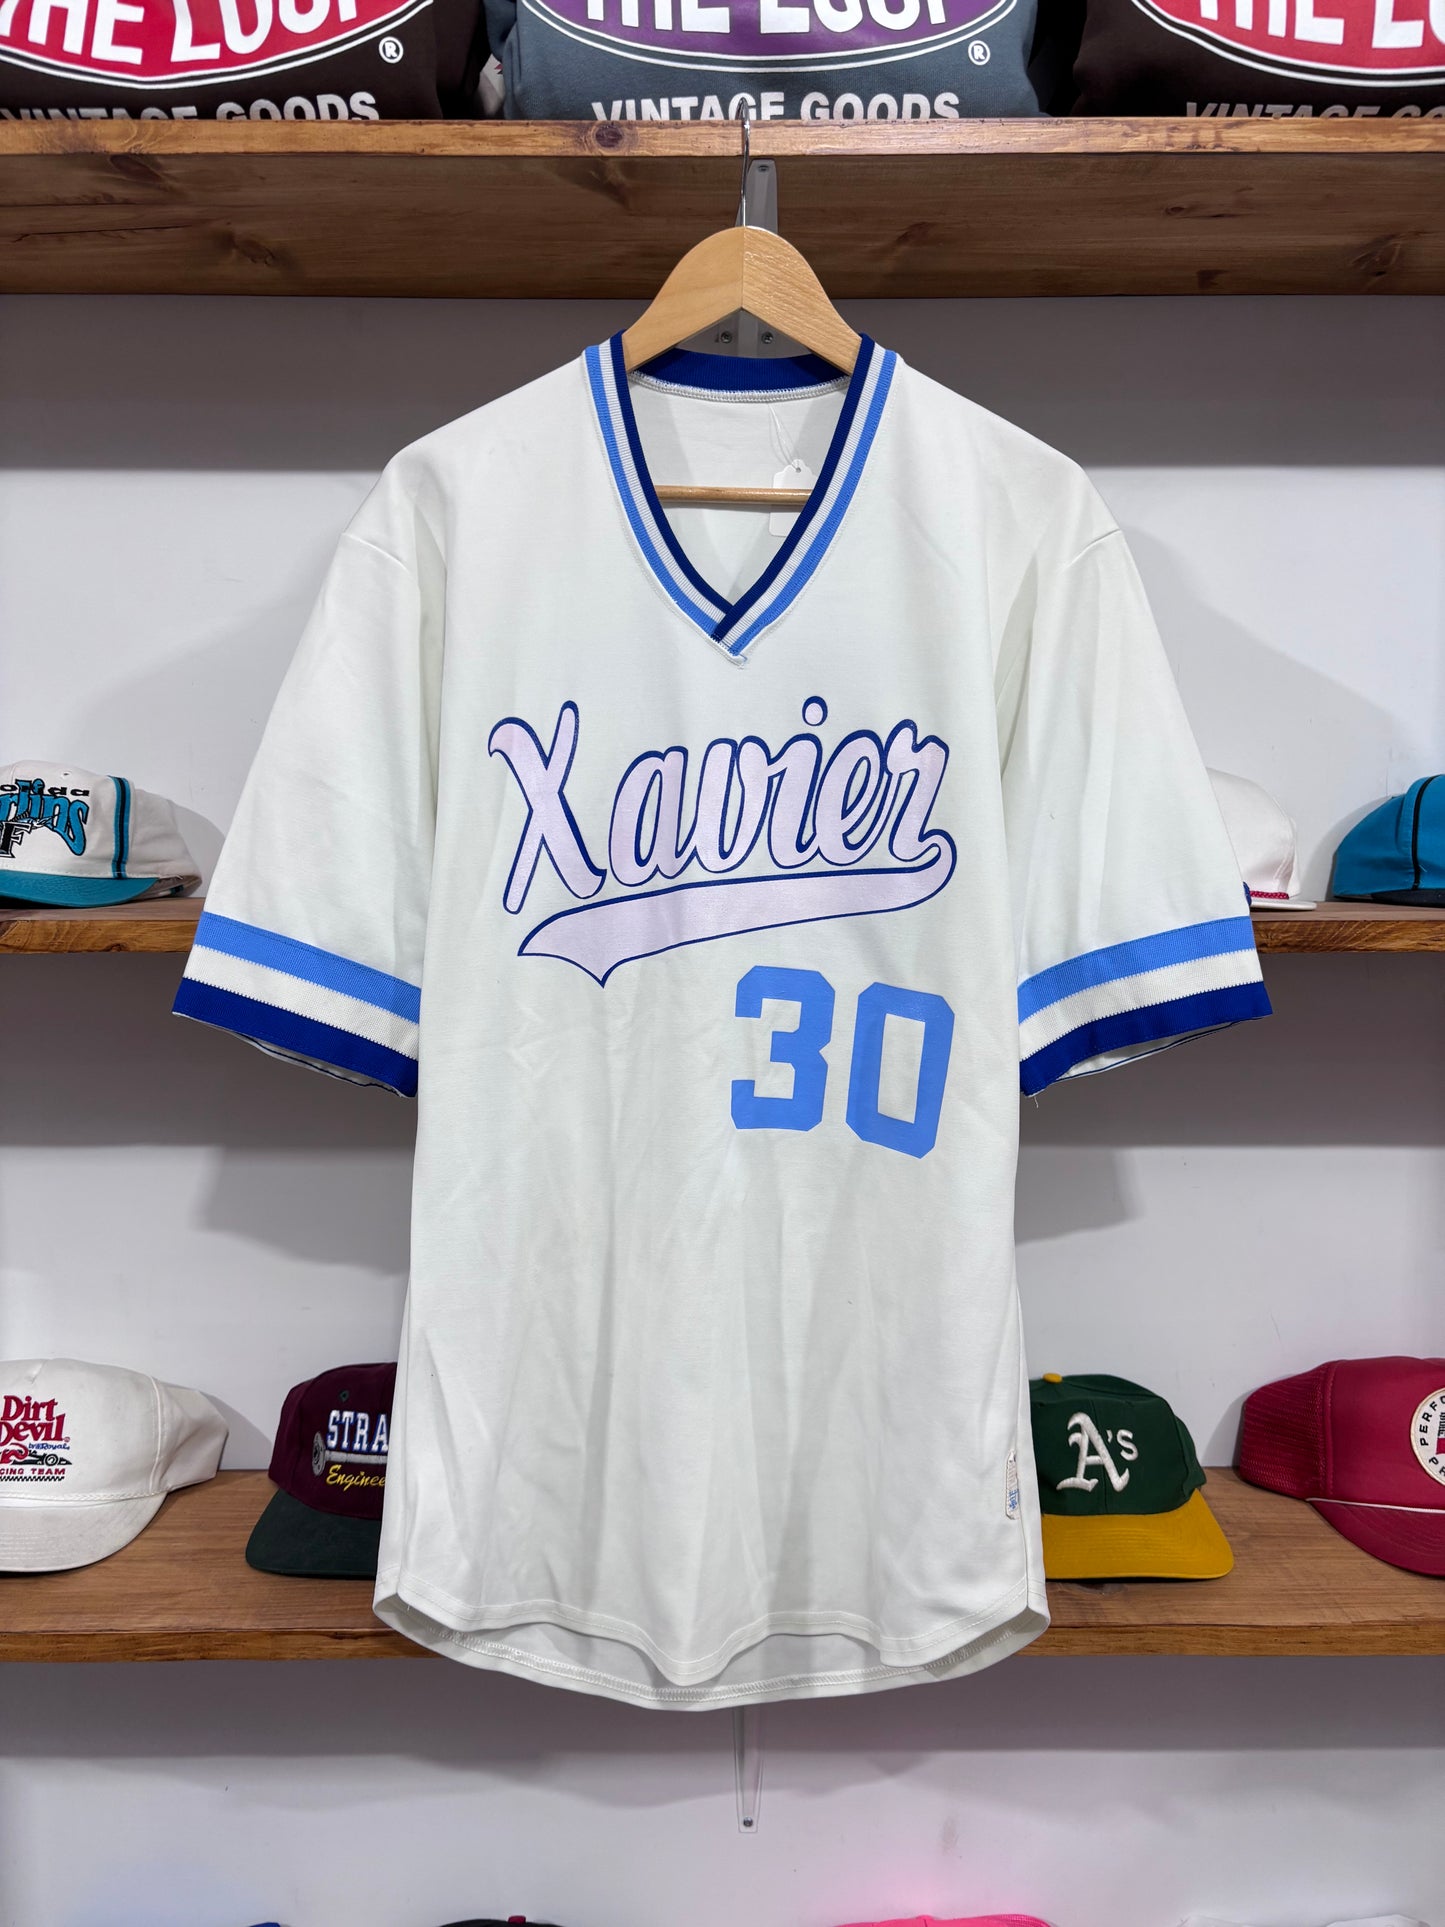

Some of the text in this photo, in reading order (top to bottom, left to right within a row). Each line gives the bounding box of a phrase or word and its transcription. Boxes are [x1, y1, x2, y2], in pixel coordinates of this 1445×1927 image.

[800, 92, 960, 121] GOODS
[488, 696, 957, 914] Xavier
[731, 966, 955, 1160] 30
[1, 1395, 58, 1421] Dirt
[0, 1413, 66, 1446] Devil
[326, 1409, 389, 1453] STRA
[1055, 1411, 1139, 1492] A's
[31, 1467, 66, 1476] TEAM
